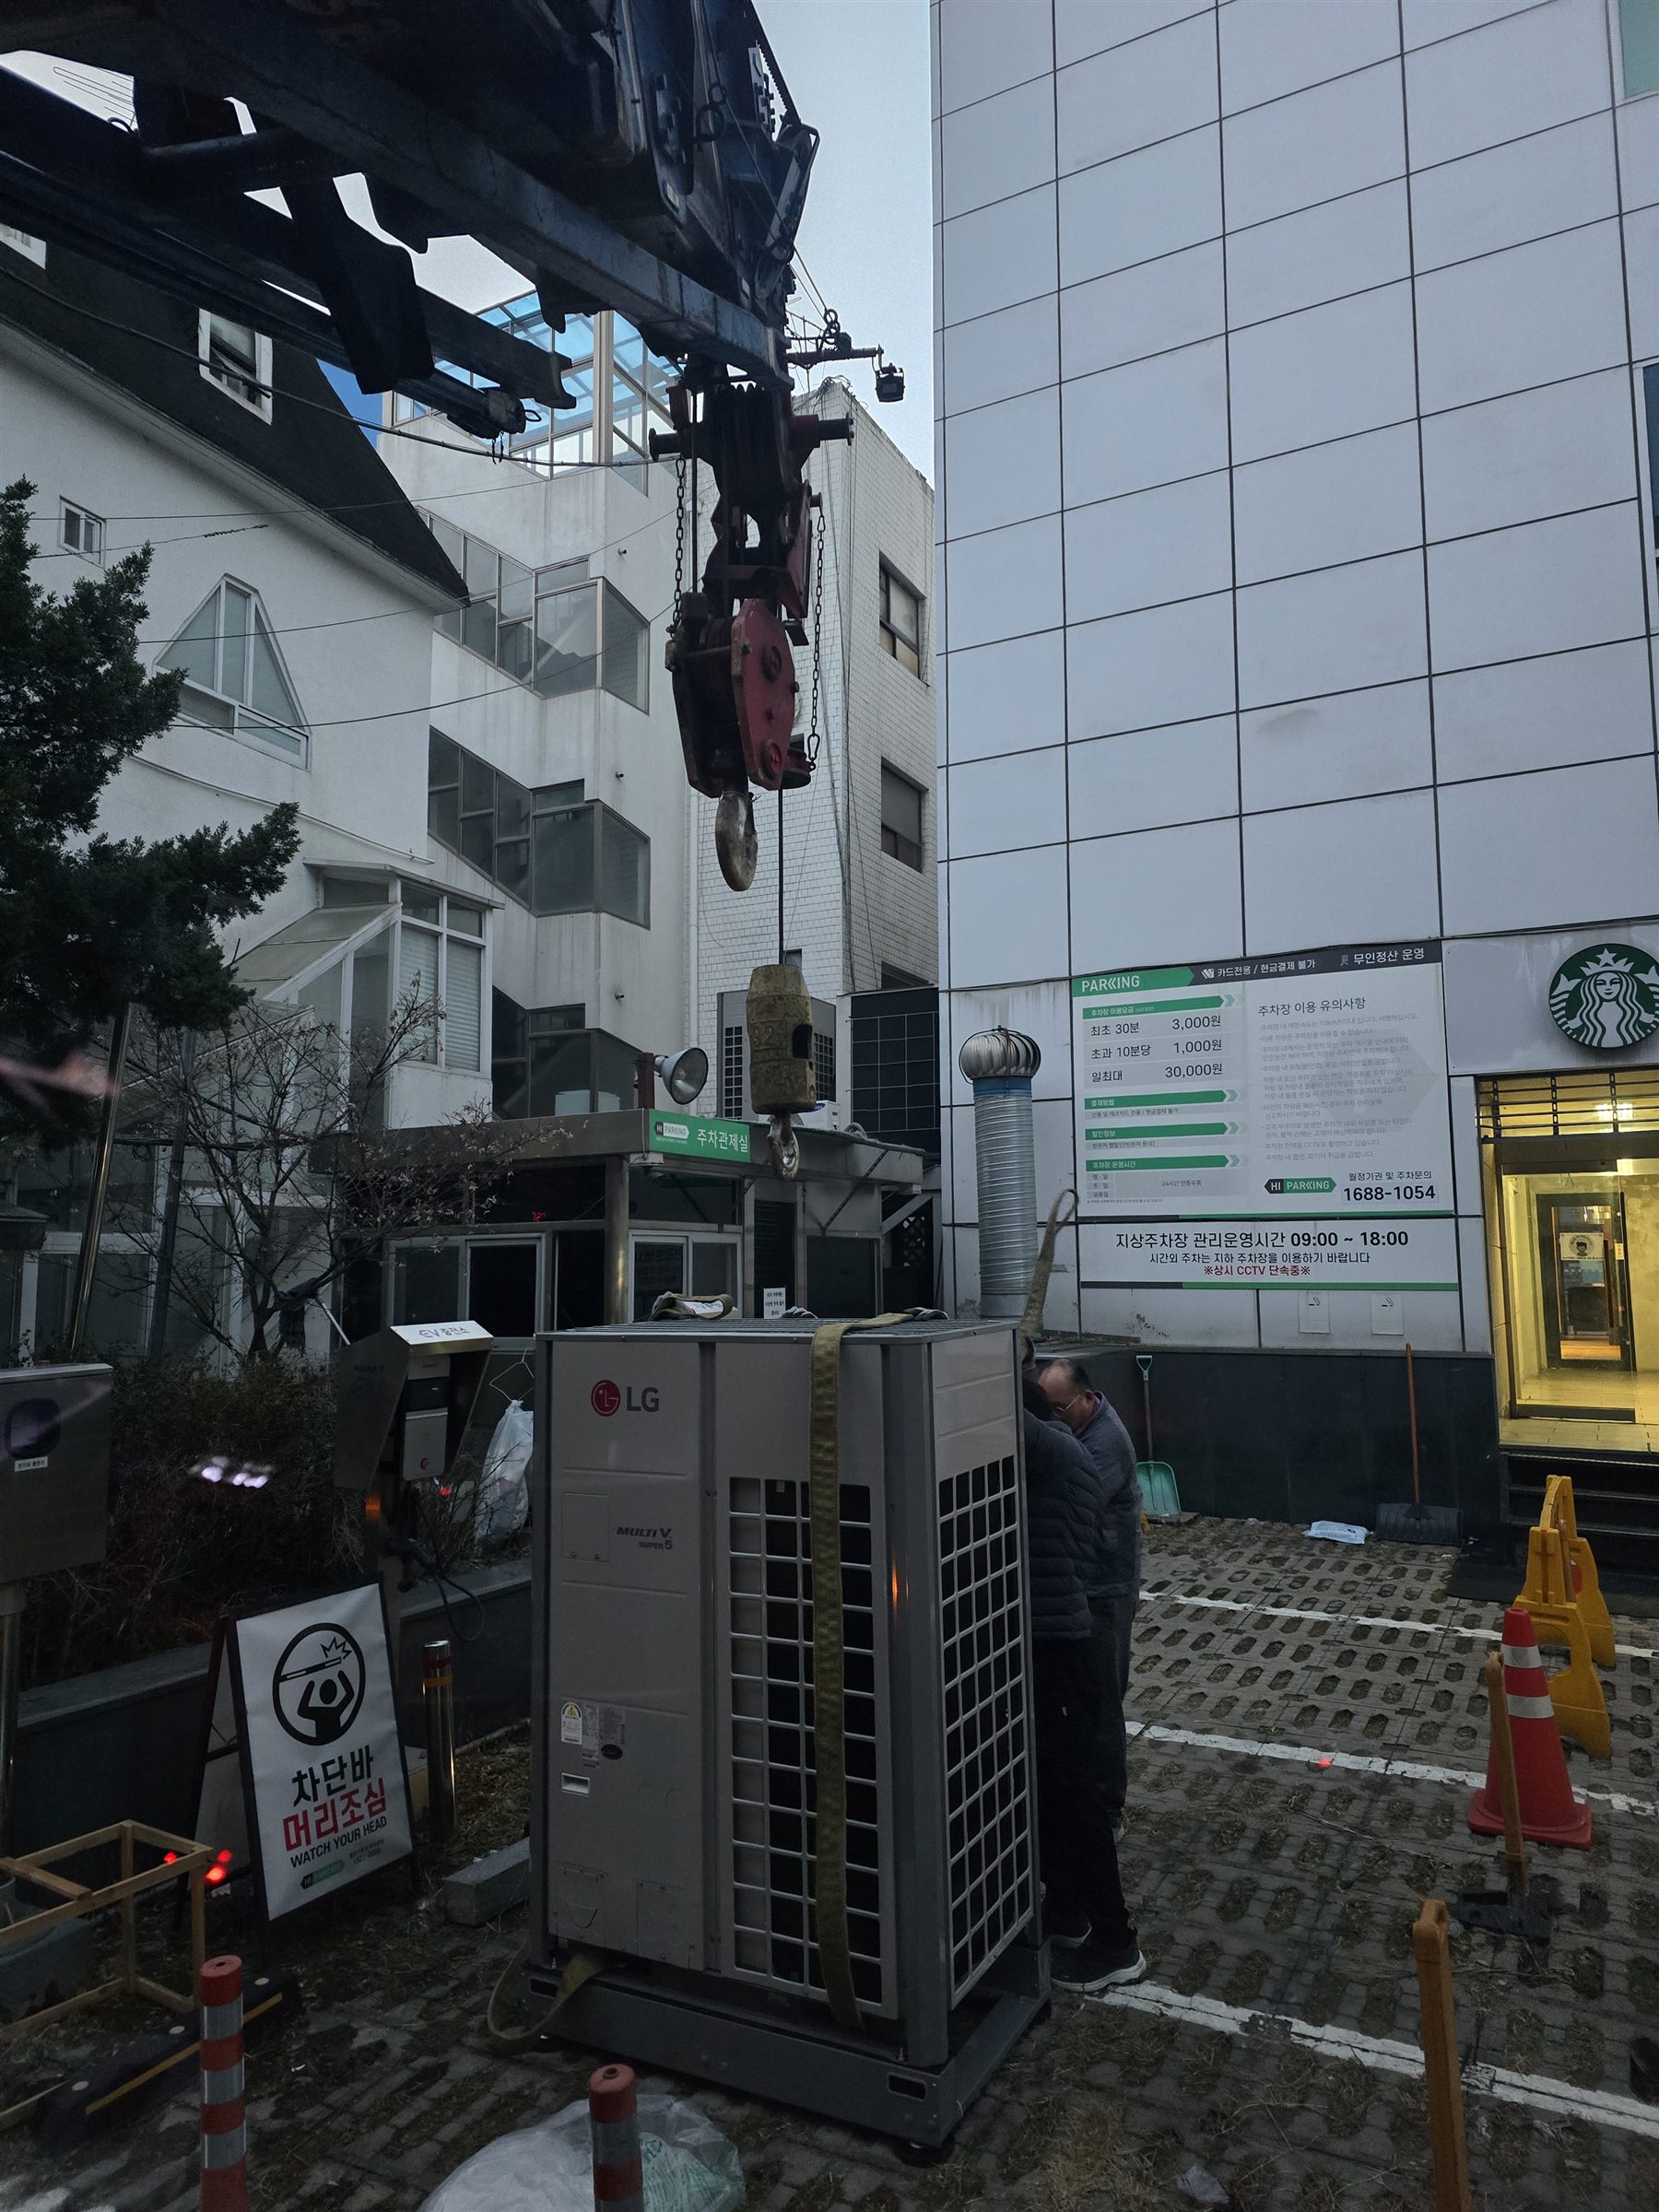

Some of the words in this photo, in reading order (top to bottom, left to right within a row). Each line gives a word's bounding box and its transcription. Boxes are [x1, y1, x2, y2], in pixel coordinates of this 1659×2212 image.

[1354, 950, 1398, 965] 무인정산
[1402, 947, 1425, 960] 운영
[1218, 964, 1252, 978] 카드전용
[1261, 960, 1295, 973] 현금결제
[1298, 959, 1316, 971] 불가
[1081, 975, 1140, 993] PARKING
[1258, 1003, 1290, 1018] 주차장
[1294, 1001, 1317, 1014] 이용
[1319, 996, 1367, 1012] 유의사항
[1091, 1024, 1111, 1037] 최초
[1115, 1022, 1140, 1034] 30분
[1171, 1015, 1221, 1030] 3,000원
[1091, 1049, 1112, 1060] 초과
[1116, 1044, 1151, 1058] 10분당
[1173, 1039, 1222, 1054] 1,000원
[1091, 1070, 1123, 1083] 일최대
[1165, 1063, 1223, 1078] 30,000원
[697, 1128, 748, 1153] 주차관제실
[1092, 1160, 1111, 1169] 주차장
[1112, 1159, 1136, 1168] 운영시간
[1348, 1171, 1382, 1182] 월정기권
[1385, 1171, 1394, 1180] 및
[1397, 1171, 1432, 1180] 주차문의
[1270, 1182, 1281, 1191] HI
[1287, 1180, 1330, 1191] PARKING
[1344, 1184, 1436, 1201] 1688-1054
[1116, 1232, 1188, 1249] 지상주차장
[1194, 1231, 1286, 1248] 관리운영시간
[1291, 1232, 1338, 1247] 09:00
[1360, 1231, 1408, 1246] 18:00
[1150, 1253, 1178, 1264] 시간외
[1182, 1253, 1210, 1264] 주차는
[1215, 1253, 1234, 1264] 지하
[1237, 1253, 1277, 1264] 주차장을
[1281, 1253, 1324, 1264] 이용하기
[1326, 1253, 1371, 1264] 바랍니다
[1237, 1265, 1265, 1276] CCTV
[626, 1386, 660, 1413] LG
[616, 1526, 657, 1537] MULTI
[639, 1541, 664, 1549] SUPER
[665, 1540, 673, 1550] 5
[292, 1745, 374, 1807] 차단바
[283, 1777, 387, 1852] 머리조심
[290, 1841, 330, 1868] WATCH
[334, 1828, 361, 1850] YOUR
[363, 1816, 387, 1836] HEAD
